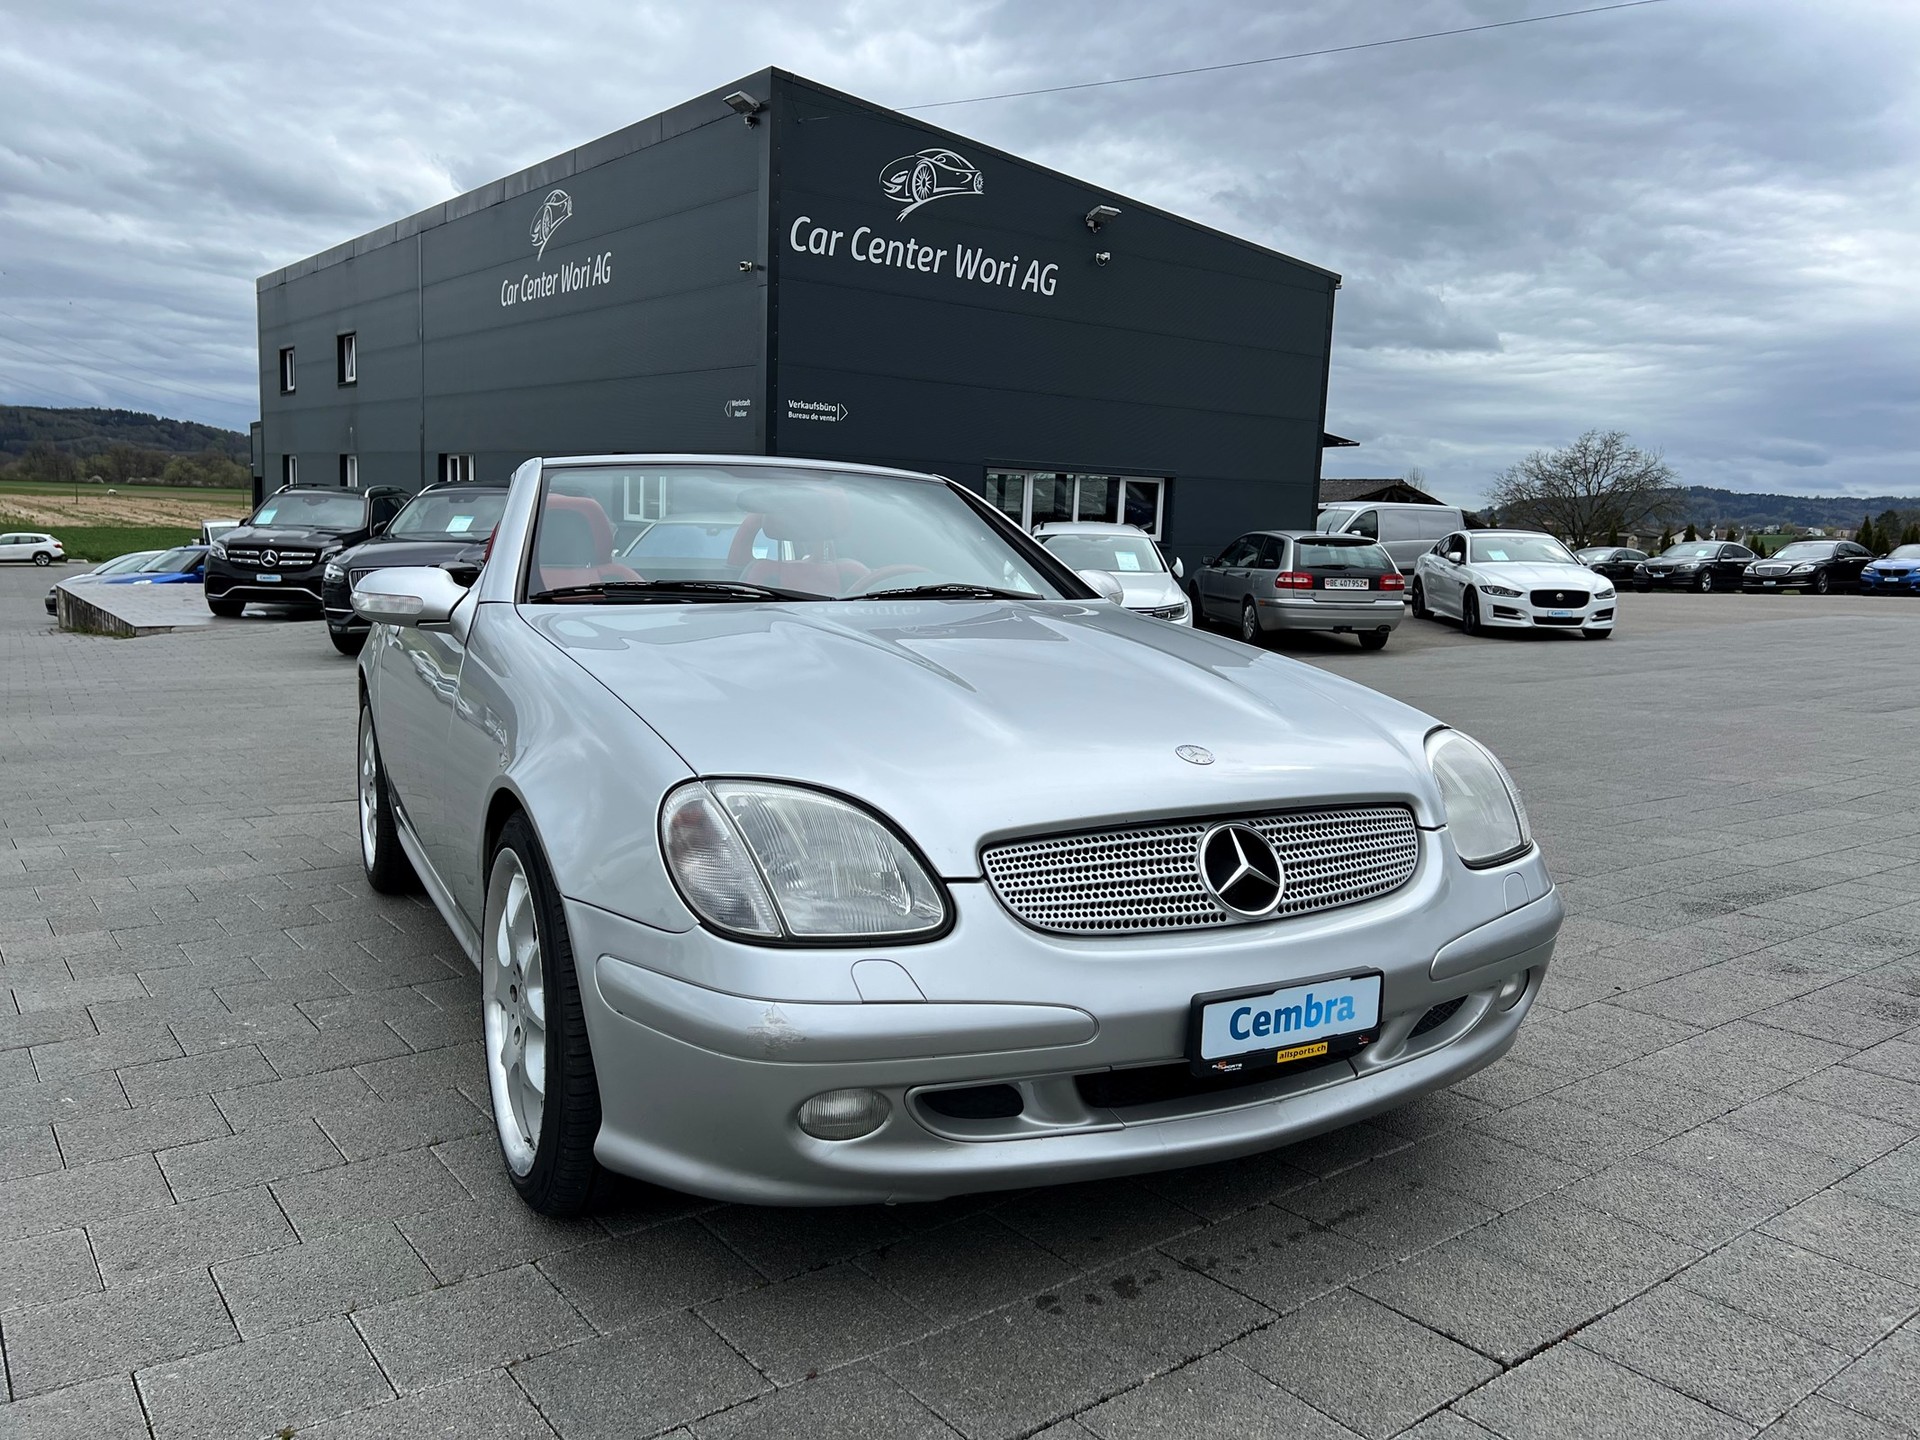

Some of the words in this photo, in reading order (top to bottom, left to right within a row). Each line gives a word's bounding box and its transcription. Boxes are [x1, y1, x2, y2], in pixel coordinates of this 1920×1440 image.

[789, 215, 844, 257] Car
[850, 226, 948, 274] Center
[955, 243, 1020, 288] Wori
[1020, 259, 1059, 296] AG
[500, 279, 520, 307] Car
[520, 271, 559, 302] Center
[561, 256, 591, 293] Wori
[592, 251, 612, 284] AG
[787, 399, 837, 412] Verkaufsbüro
[787, 410, 810, 420] Bureau
[810, 412, 819, 420] de
[1229, 993, 1356, 1041] Cembra
[1279, 1044, 1327, 1059] allsports.ch
